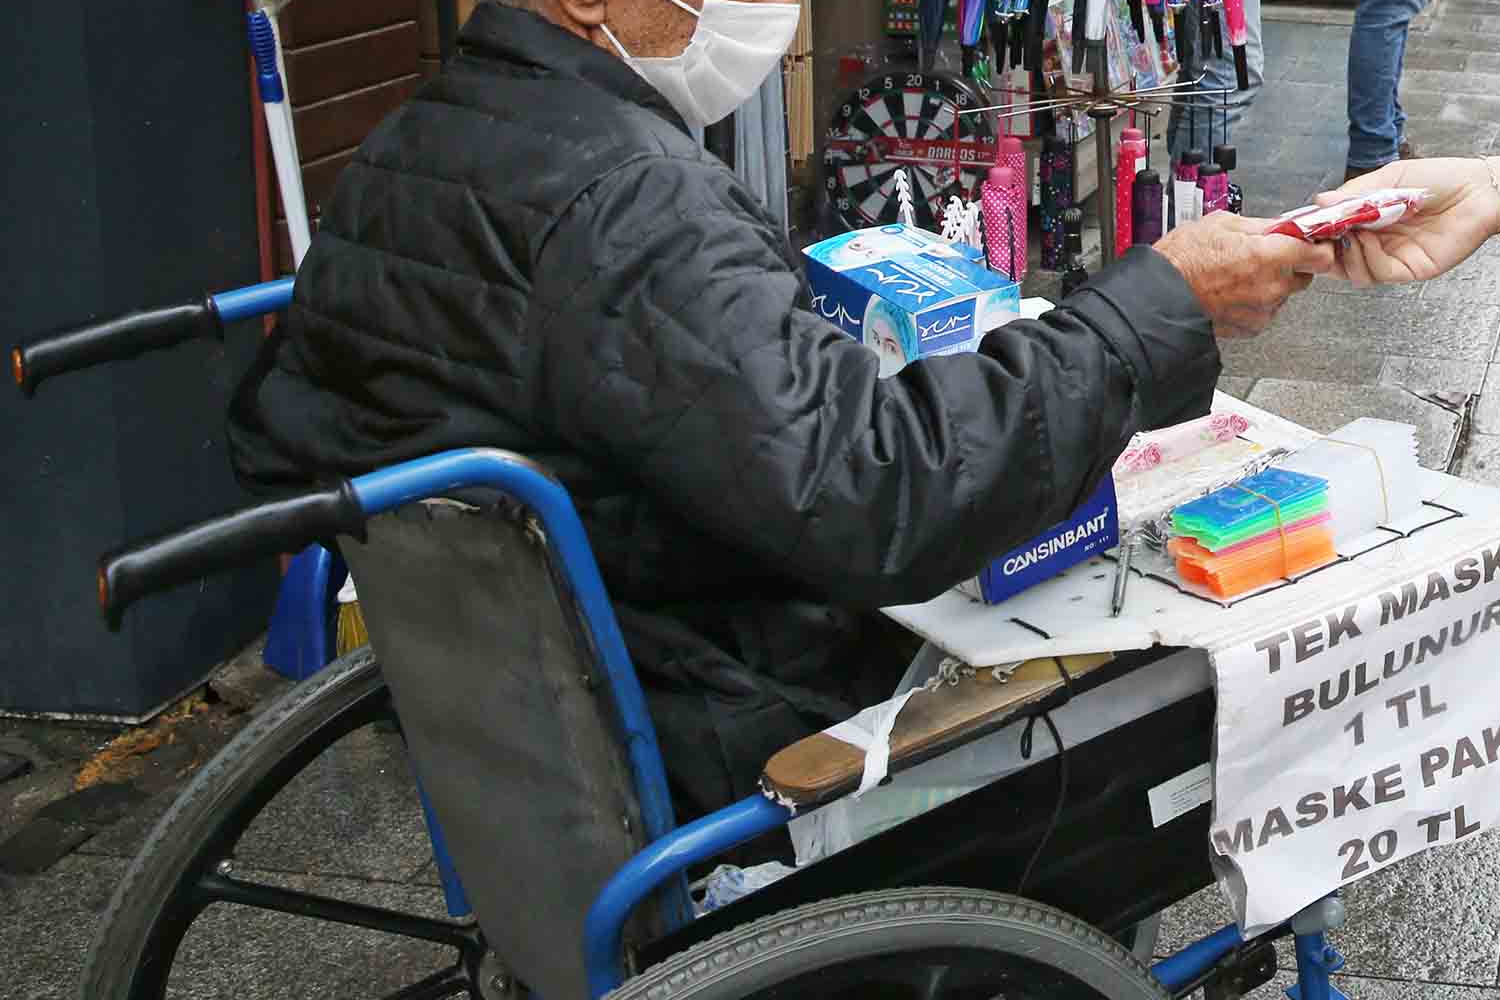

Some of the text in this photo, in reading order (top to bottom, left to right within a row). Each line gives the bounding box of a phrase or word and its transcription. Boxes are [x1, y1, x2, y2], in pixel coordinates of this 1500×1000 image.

[884, 76, 893, 89] 5
[906, 74, 922, 87] 20
[1003, 511, 1108, 576] CANSINBANT
[1255, 604, 1362, 674] TEK
[1343, 683, 1448, 747] 1 TL
[1211, 762, 1406, 854] MASKE
[1336, 804, 1482, 881] 20 TL
